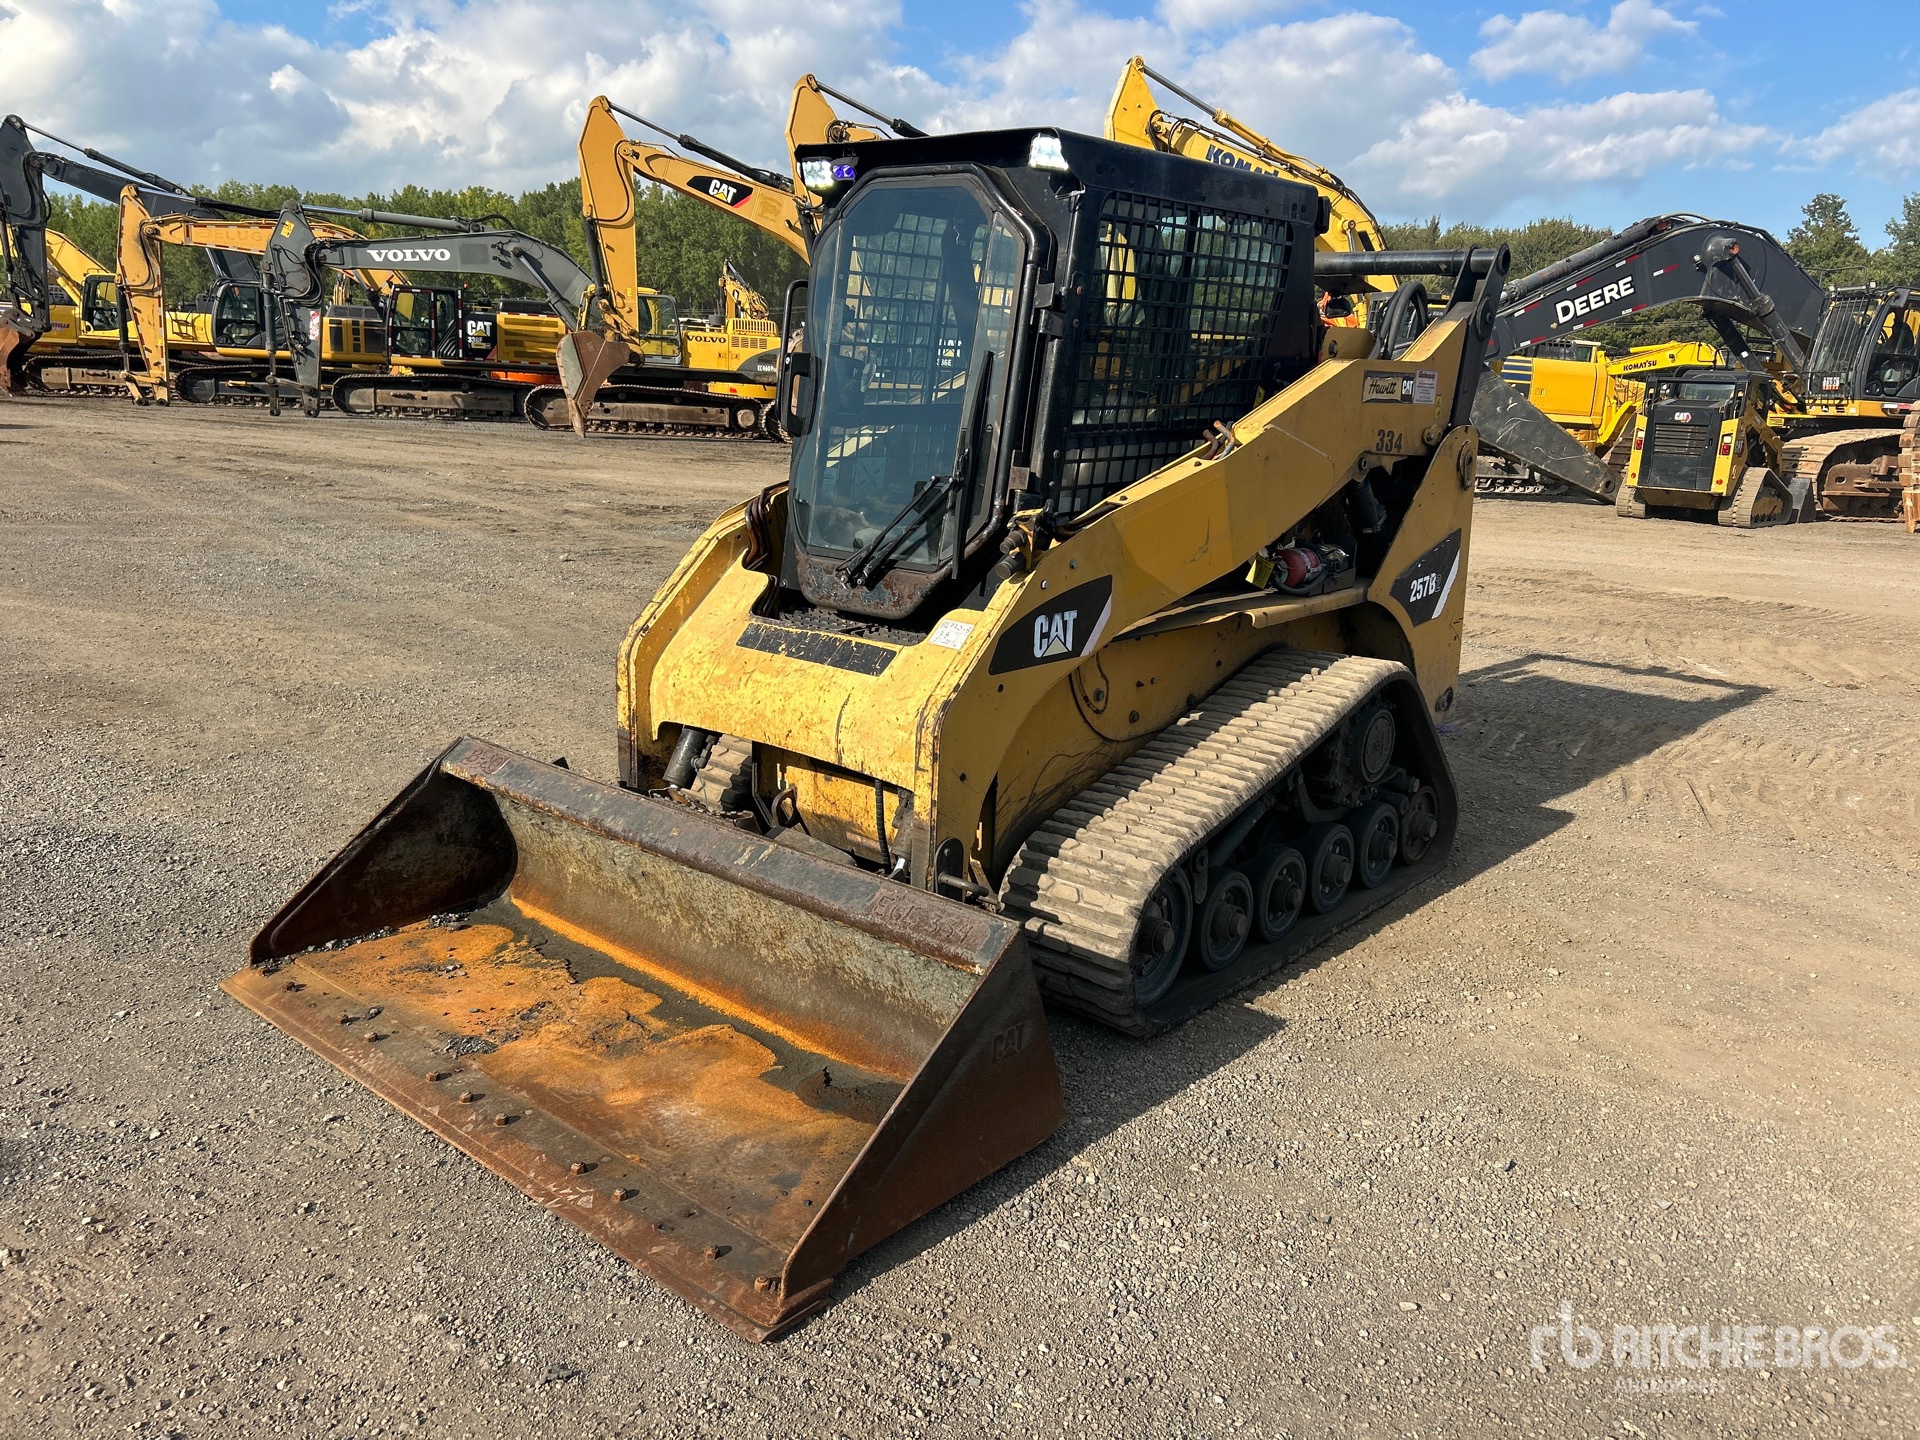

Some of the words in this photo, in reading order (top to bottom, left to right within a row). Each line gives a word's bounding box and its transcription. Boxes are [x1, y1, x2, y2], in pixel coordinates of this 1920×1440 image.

[708, 179, 737, 204] CAT
[367, 248, 451, 262] VOLVO
[1555, 276, 1634, 324] DEERE
[467, 320, 492, 337] CAT
[685, 334, 727, 344] VOLVO
[1623, 360, 1657, 371] KOMATSU
[1368, 379, 1397, 395] Hewitt
[1402, 380, 1414, 395] CAT
[1674, 412, 1689, 421] CAT
[1376, 429, 1403, 452] 334
[1034, 610, 1077, 658] CAT
[991, 1022, 1026, 1064] CAT
